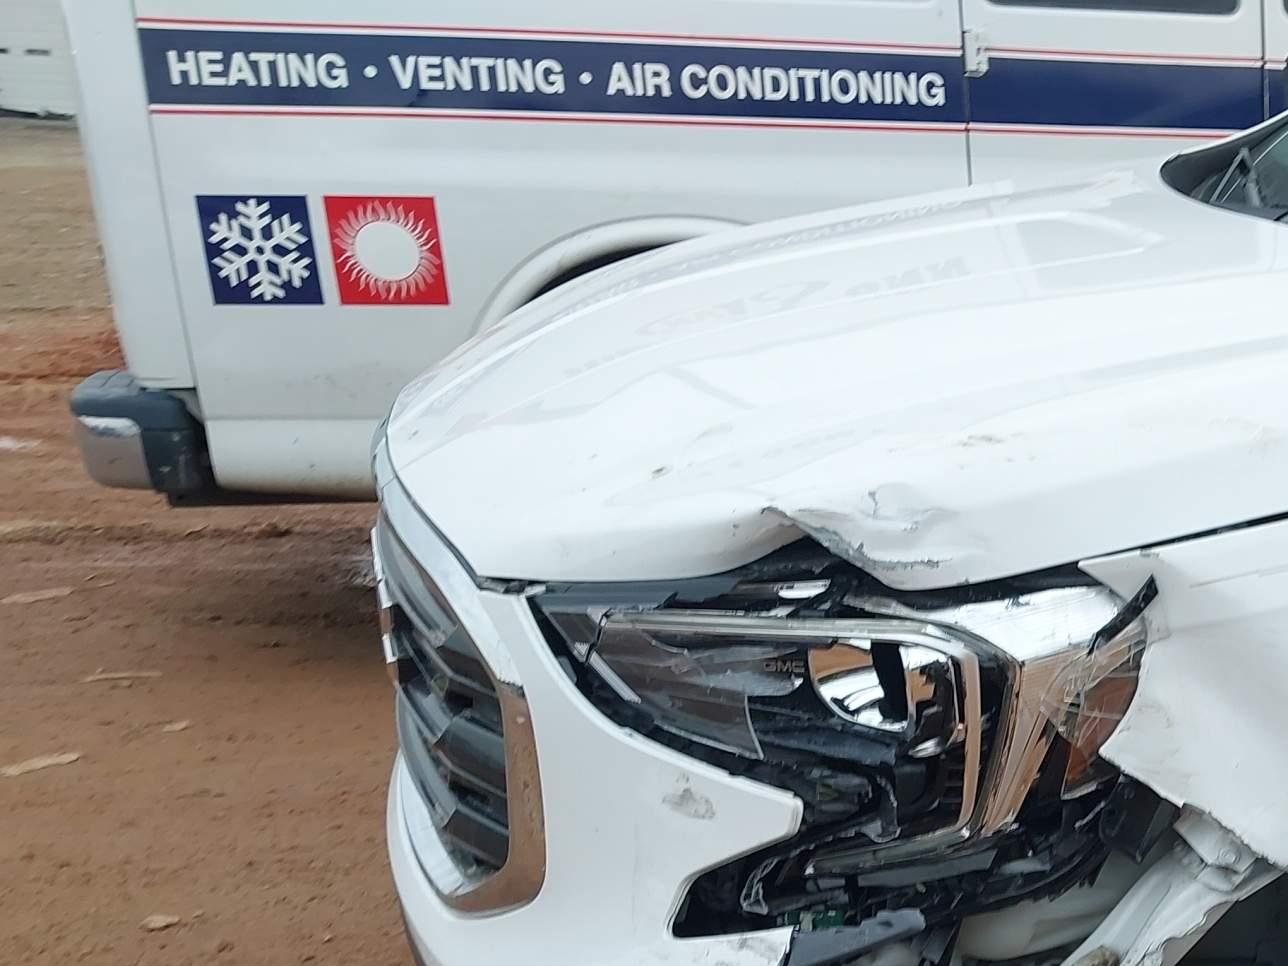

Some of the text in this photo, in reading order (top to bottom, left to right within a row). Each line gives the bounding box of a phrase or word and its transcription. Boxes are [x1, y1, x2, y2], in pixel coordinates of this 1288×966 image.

[165, 49, 946, 107] HEATING VENTING AIR CONDITIONING
